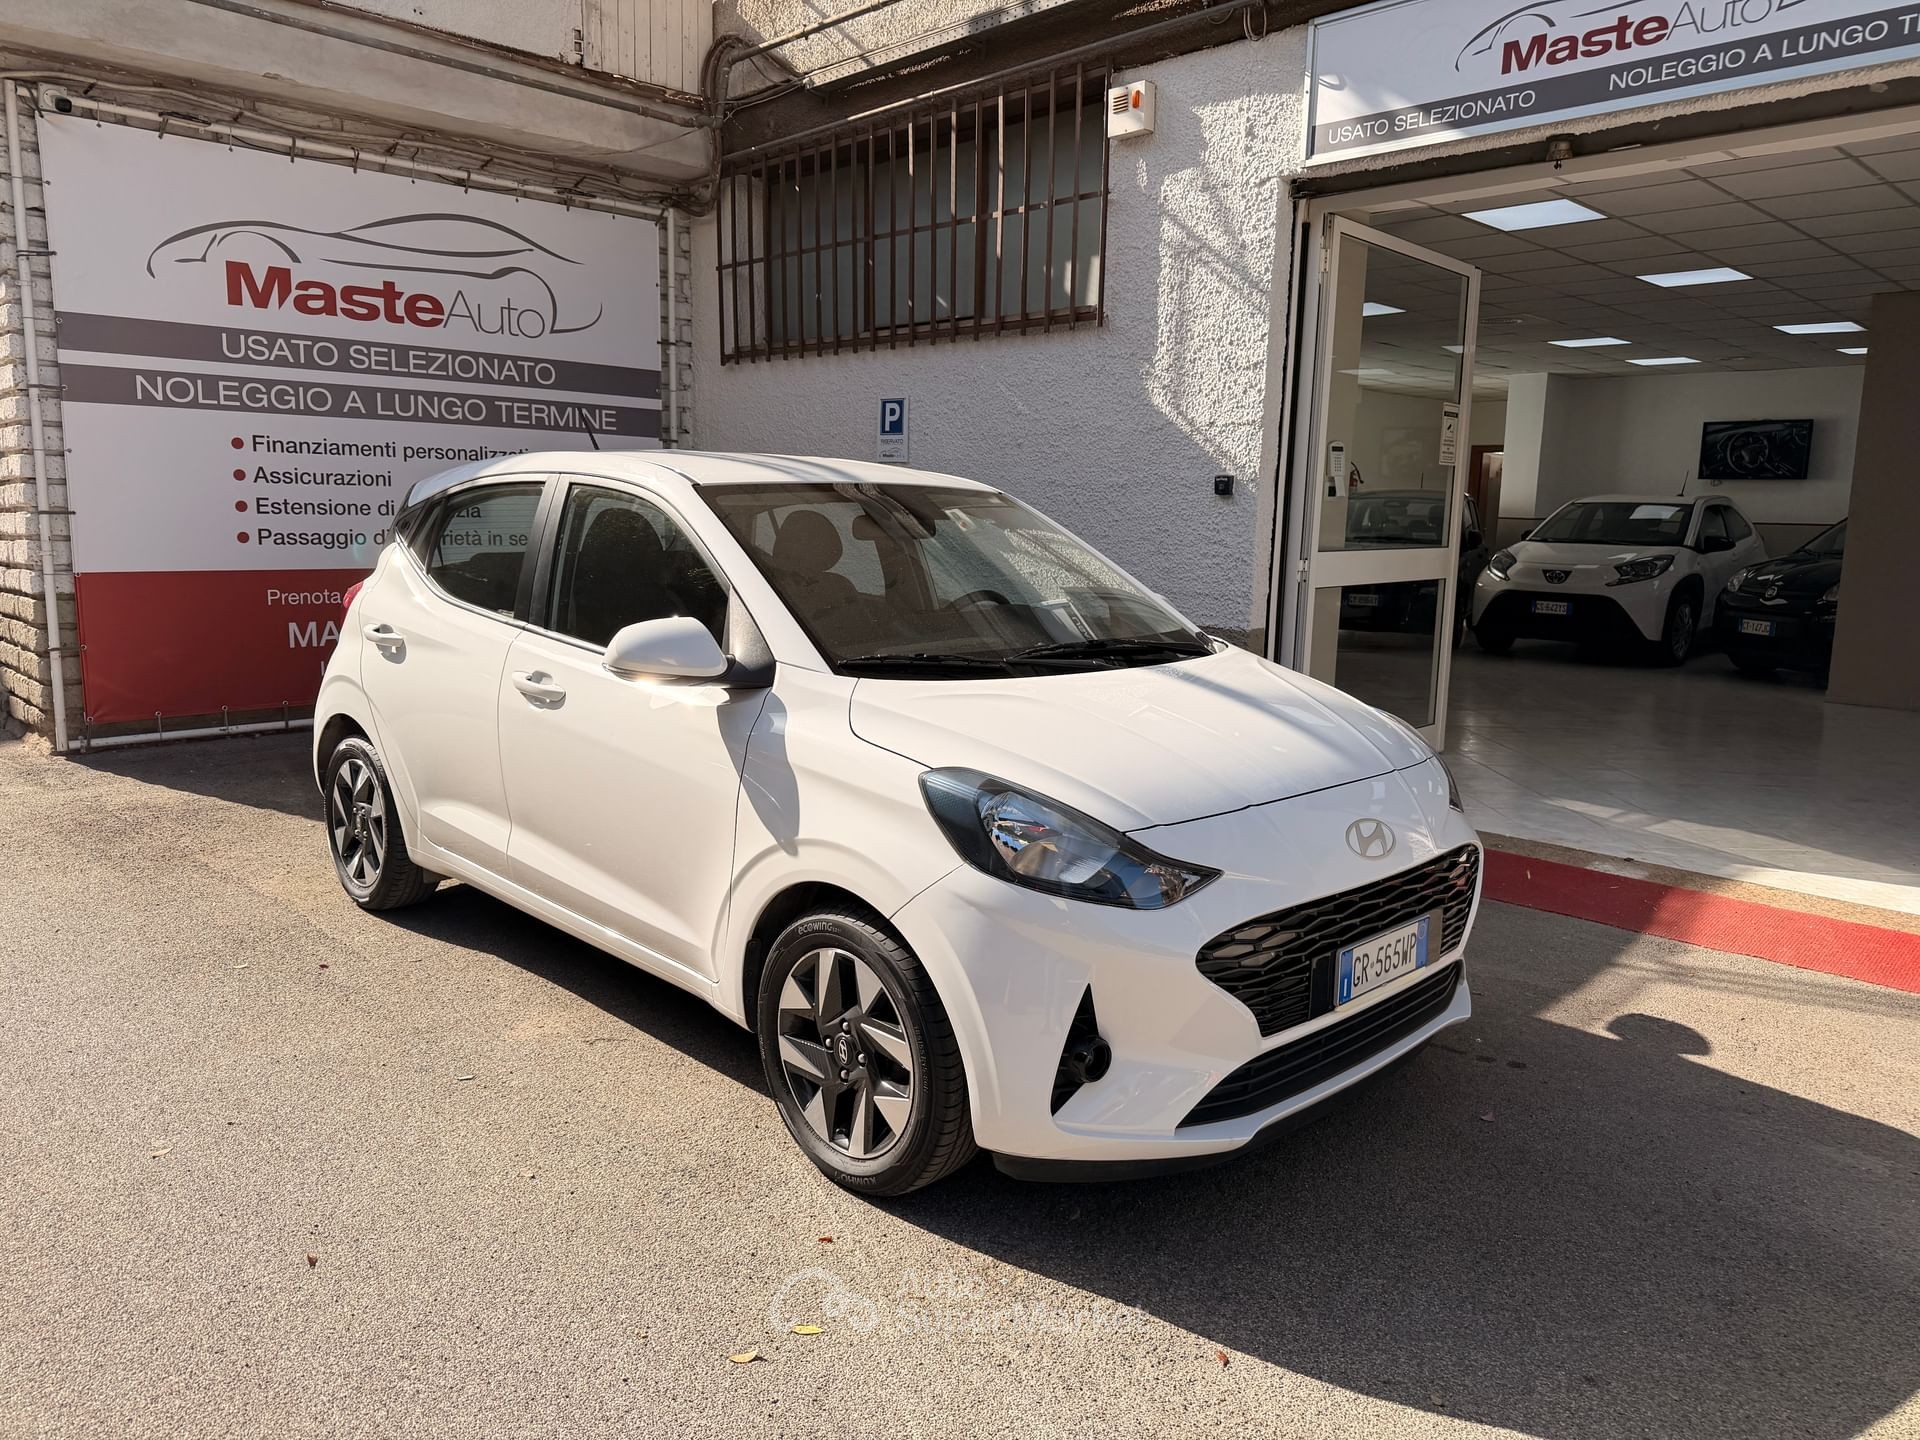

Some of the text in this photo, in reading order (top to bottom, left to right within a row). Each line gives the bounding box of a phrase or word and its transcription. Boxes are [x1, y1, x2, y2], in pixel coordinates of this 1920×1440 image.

[1609, 48, 1746, 91] NOLEGGIO
[1752, 43, 1773, 64] A
[1781, 20, 1889, 58] LUNGO
[1328, 89, 1536, 145] USATO SELEZIONATO
[221, 332, 556, 386] USATO SELEZIONATO
[135, 374, 617, 430] NOLEGGIO A LUNGO TERMINE
[885, 402, 900, 432] P
[252, 434, 397, 458] Finanziamenti
[253, 467, 392, 487] Assicurazioni
[256, 498, 395, 516] Estensione di
[257, 528, 367, 551] Passaggio
[373, 529, 390, 545] d
[488, 531, 505, 546] in
[267, 588, 342, 606] Prenota
[1353, 953, 1370, 988] GR
[1375, 932, 1416, 977] 565WP
